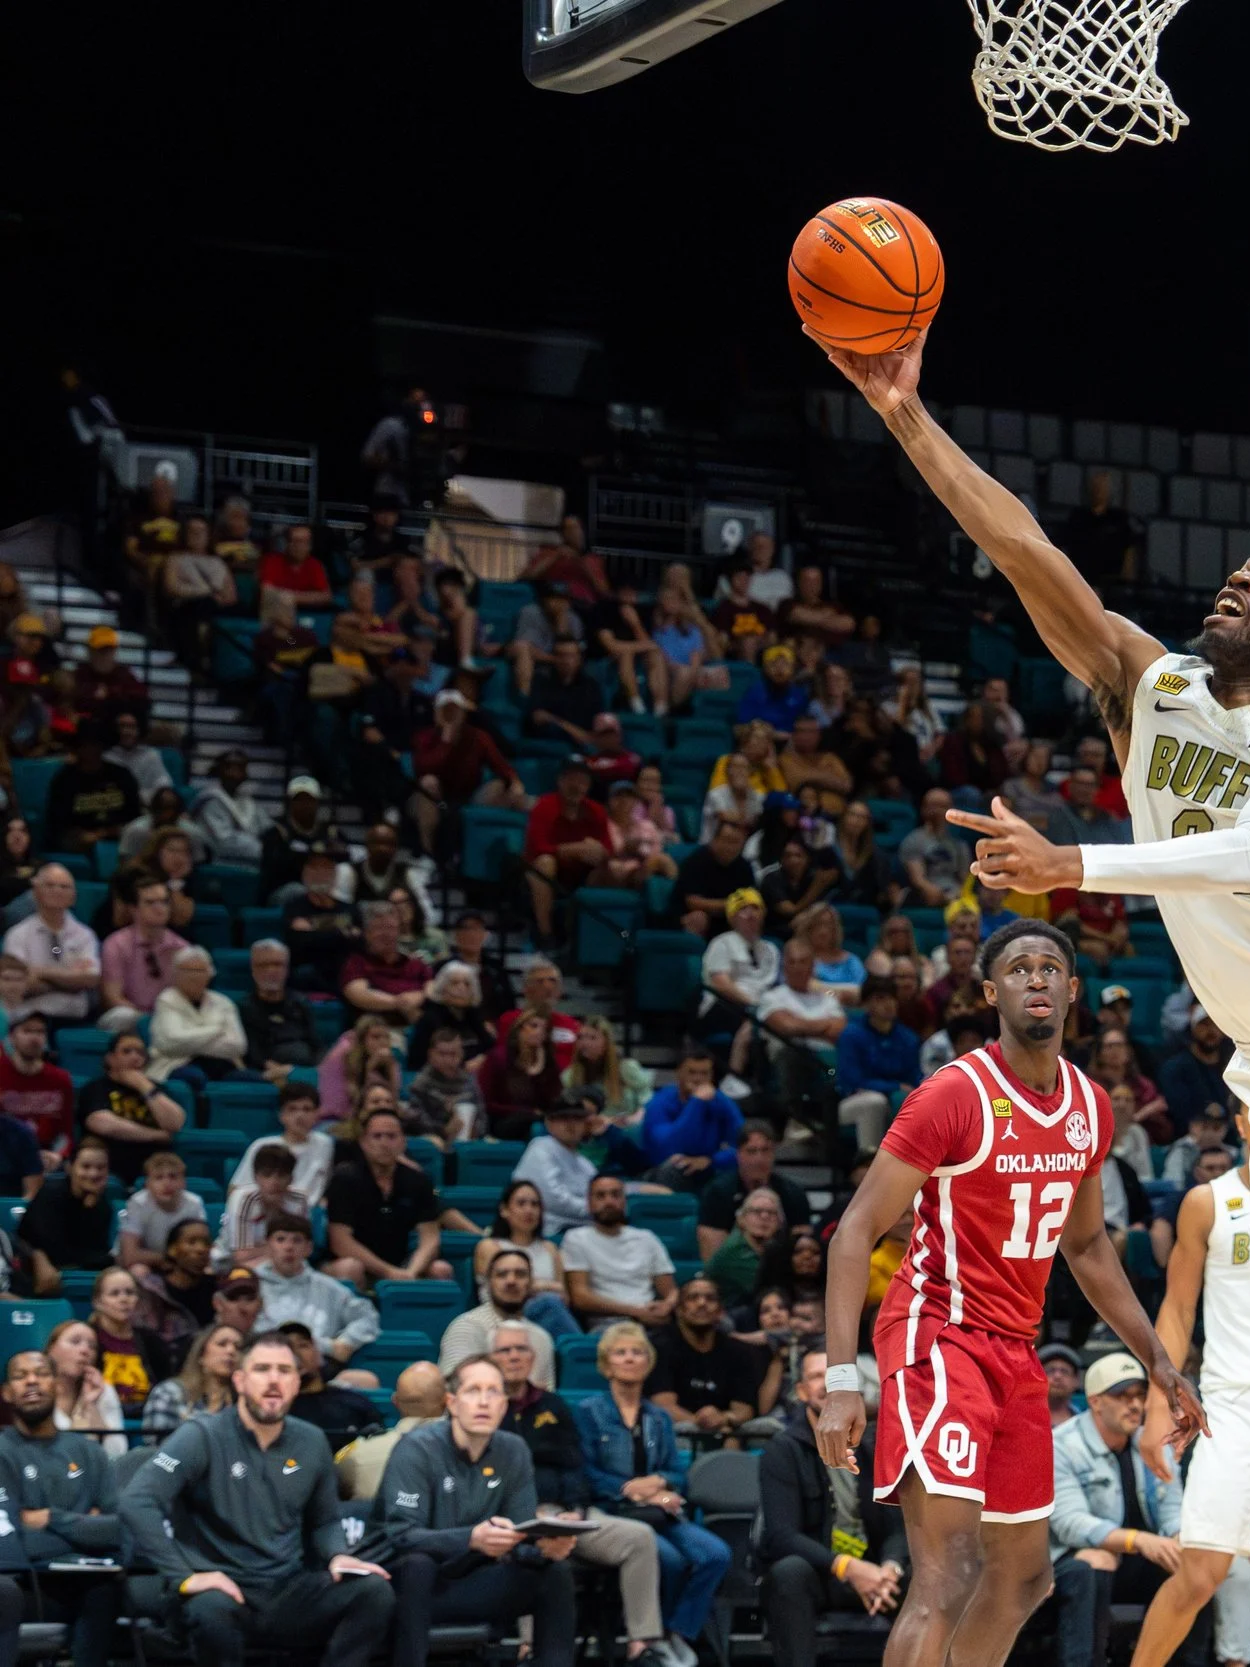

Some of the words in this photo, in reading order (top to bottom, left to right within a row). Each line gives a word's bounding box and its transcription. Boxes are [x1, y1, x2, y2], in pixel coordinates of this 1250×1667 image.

[995, 1153, 1087, 1173] OKLAHOMA
[1001, 1181, 1074, 1260] 12
[938, 1421, 979, 1478] OU
